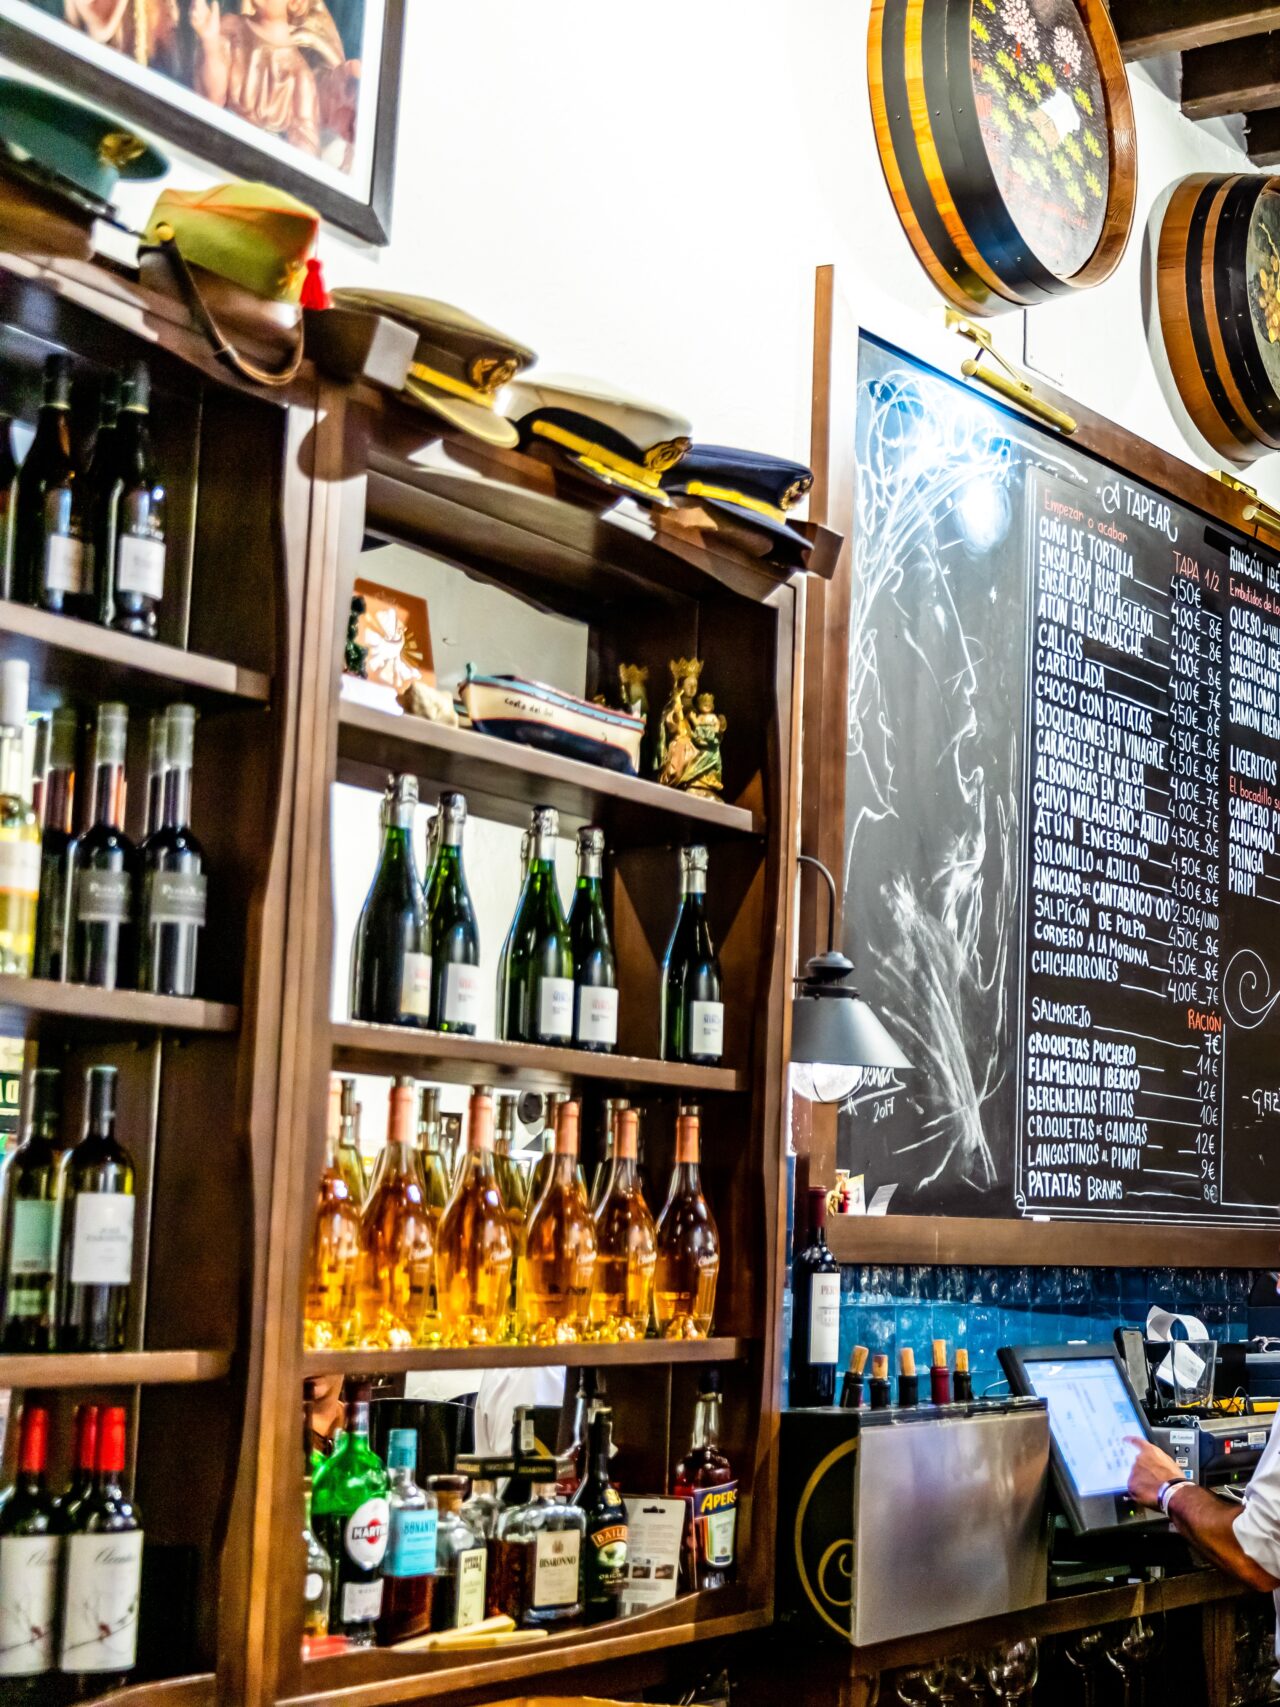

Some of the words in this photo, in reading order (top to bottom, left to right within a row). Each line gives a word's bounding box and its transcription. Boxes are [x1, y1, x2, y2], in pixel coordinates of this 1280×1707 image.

[1045, 489, 1084, 521] Empezar
[1098, 522, 1128, 543] acabar
[1123, 485, 1178, 542] TAPEAR
[1039, 516, 1067, 547] CUÑA
[1072, 530, 1085, 557] DE
[1088, 534, 1134, 579] TORTILLA
[1230, 546, 1263, 582] RINCÓN
[1039, 542, 1092, 585] ENSALADA
[1095, 561, 1121, 598] RUSA
[1173, 550, 1200, 582] TAPA
[1204, 571, 1219, 592] 1/2
[1039, 567, 1090, 608] ENSALADA
[1094, 588, 1153, 638] MALAGUEÑA
[1230, 578, 1262, 609] Embutidos
[1038, 592, 1067, 626] ATÚN
[1072, 603, 1085, 635] EN
[1087, 608, 1145, 659] ESCABECHE
[1229, 606, 1261, 638] QUESO
[1037, 623, 1083, 661] CALLOS
[1230, 631, 1266, 664] CHORIZO
[1036, 649, 1105, 693] CARRILLADA
[1035, 675, 1076, 708] CHOCO
[1080, 690, 1103, 719] CON
[1107, 697, 1152, 736] PATATAS
[1230, 701, 1259, 733] JAMON
[1254, 687, 1276, 715] LOMO
[1036, 699, 1105, 747] BOQUERONES
[1108, 726, 1121, 753] EN
[1124, 731, 1165, 770] VINAGRE
[1205, 764, 1219, 786] 8€
[1036, 729, 1095, 769] CARACOLES
[1098, 752, 1111, 776] EN
[1114, 756, 1144, 786] SALSA
[1036, 755, 1099, 796] ALBONDIGAS
[1101, 775, 1115, 801] EN
[1118, 781, 1145, 812] SALSA
[1230, 745, 1277, 786] LIGERITOS
[1229, 797, 1269, 828] CAMPERO
[1240, 779, 1272, 807] bocadillo
[1034, 782, 1067, 812] CHIVO
[1071, 790, 1134, 834] MALAGUEÑO
[1140, 814, 1169, 845] AJILLO
[1205, 834, 1219, 858] 8€
[1035, 806, 1074, 841] ATÚN
[1082, 823, 1148, 860] ENCEBOLLAO
[1229, 820, 1275, 854] AHUMADO
[1034, 835, 1094, 872] SOLOMILLO
[1106, 857, 1139, 884] AJILLO
[1033, 865, 1081, 897] ANCHOAS
[1093, 882, 1151, 917] CANTABRICO
[1228, 869, 1256, 897] PIRIPI
[1035, 921, 1083, 947] CORDERO
[1116, 914, 1146, 939] PULPO
[1032, 951, 1118, 982] CHICHARRONES
[1032, 997, 1091, 1028] SALMOREJO
[1204, 1034, 1221, 1055] 7€
[1187, 1009, 1222, 1032] RACIÓN
[1028, 1032, 1090, 1060] CROQUETAS
[1093, 1039, 1136, 1065] PUCHERO
[1197, 1055, 1218, 1077] 11€
[1027, 1085, 1097, 1115] BERENJENAS
[1100, 1090, 1134, 1118] FRITAS
[1200, 1107, 1219, 1126] 10€
[1198, 1083, 1216, 1102] 12€
[1028, 1116, 1094, 1141] CROQUETAS
[1105, 1122, 1147, 1147] GAMBAS
[1196, 1133, 1215, 1154] 12€
[1028, 1143, 1099, 1167] LANGOSTINOS
[1111, 1148, 1140, 1169] PIMPI
[1201, 1159, 1216, 1180] 9€
[1028, 1170, 1081, 1198] PATATAS
[1087, 1176, 1122, 1201] BRAVAS
[539, 1556, 576, 1569] DISARONNO
